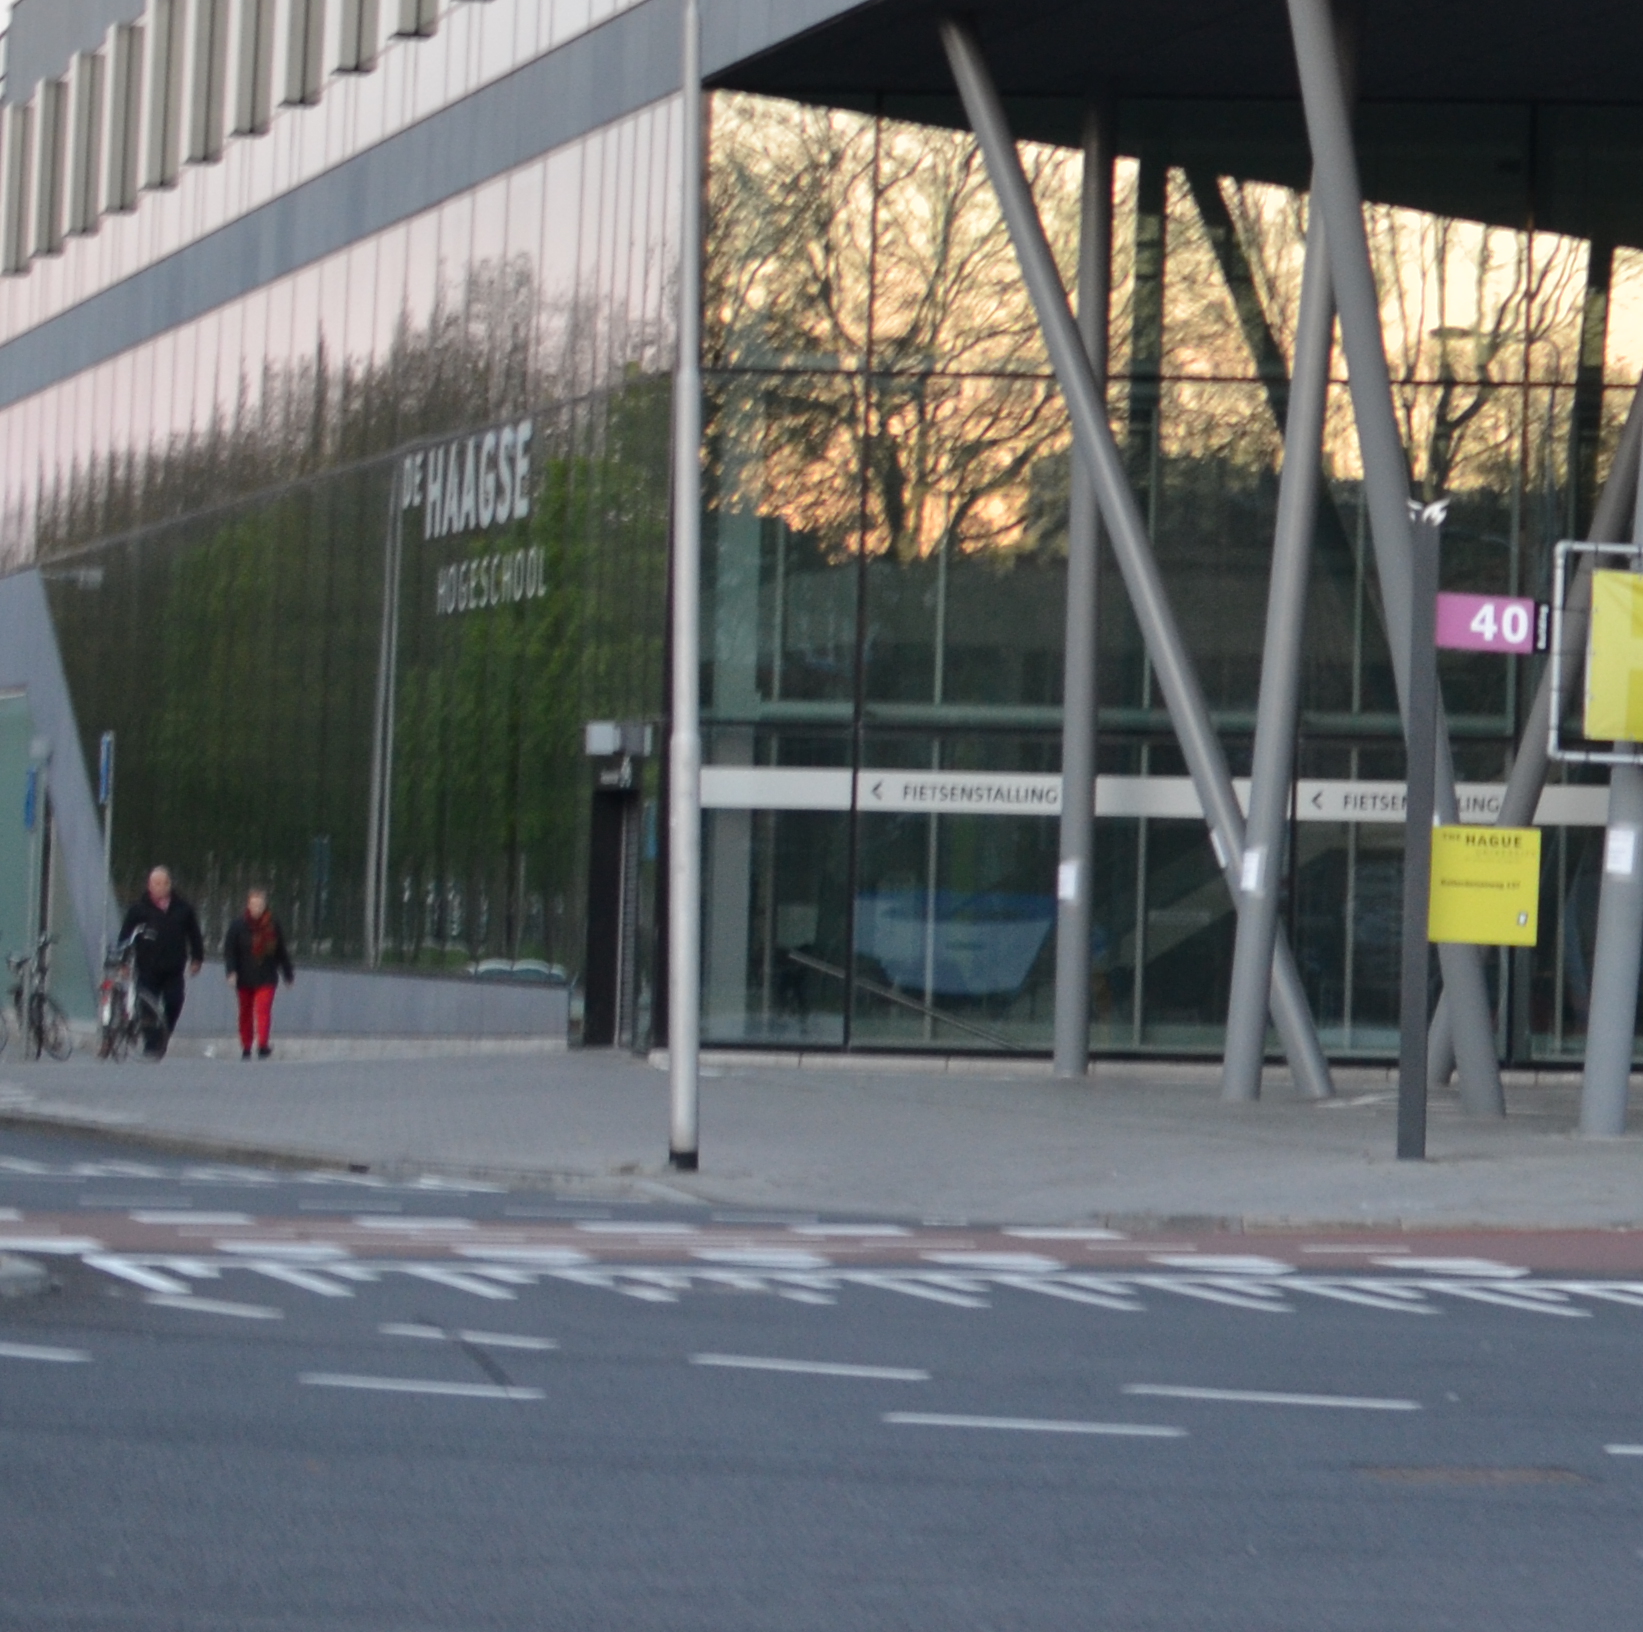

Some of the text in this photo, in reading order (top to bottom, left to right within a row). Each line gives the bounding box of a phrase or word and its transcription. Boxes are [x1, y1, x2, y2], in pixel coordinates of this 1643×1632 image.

[402, 419, 534, 541] DE HAAGSE
[437, 545, 547, 616] HOGESCHOOL
[1470, 603, 1529, 644] 40
[903, 784, 1058, 805] FIETSENSTALLING
[1465, 834, 1522, 847] HAGUE
